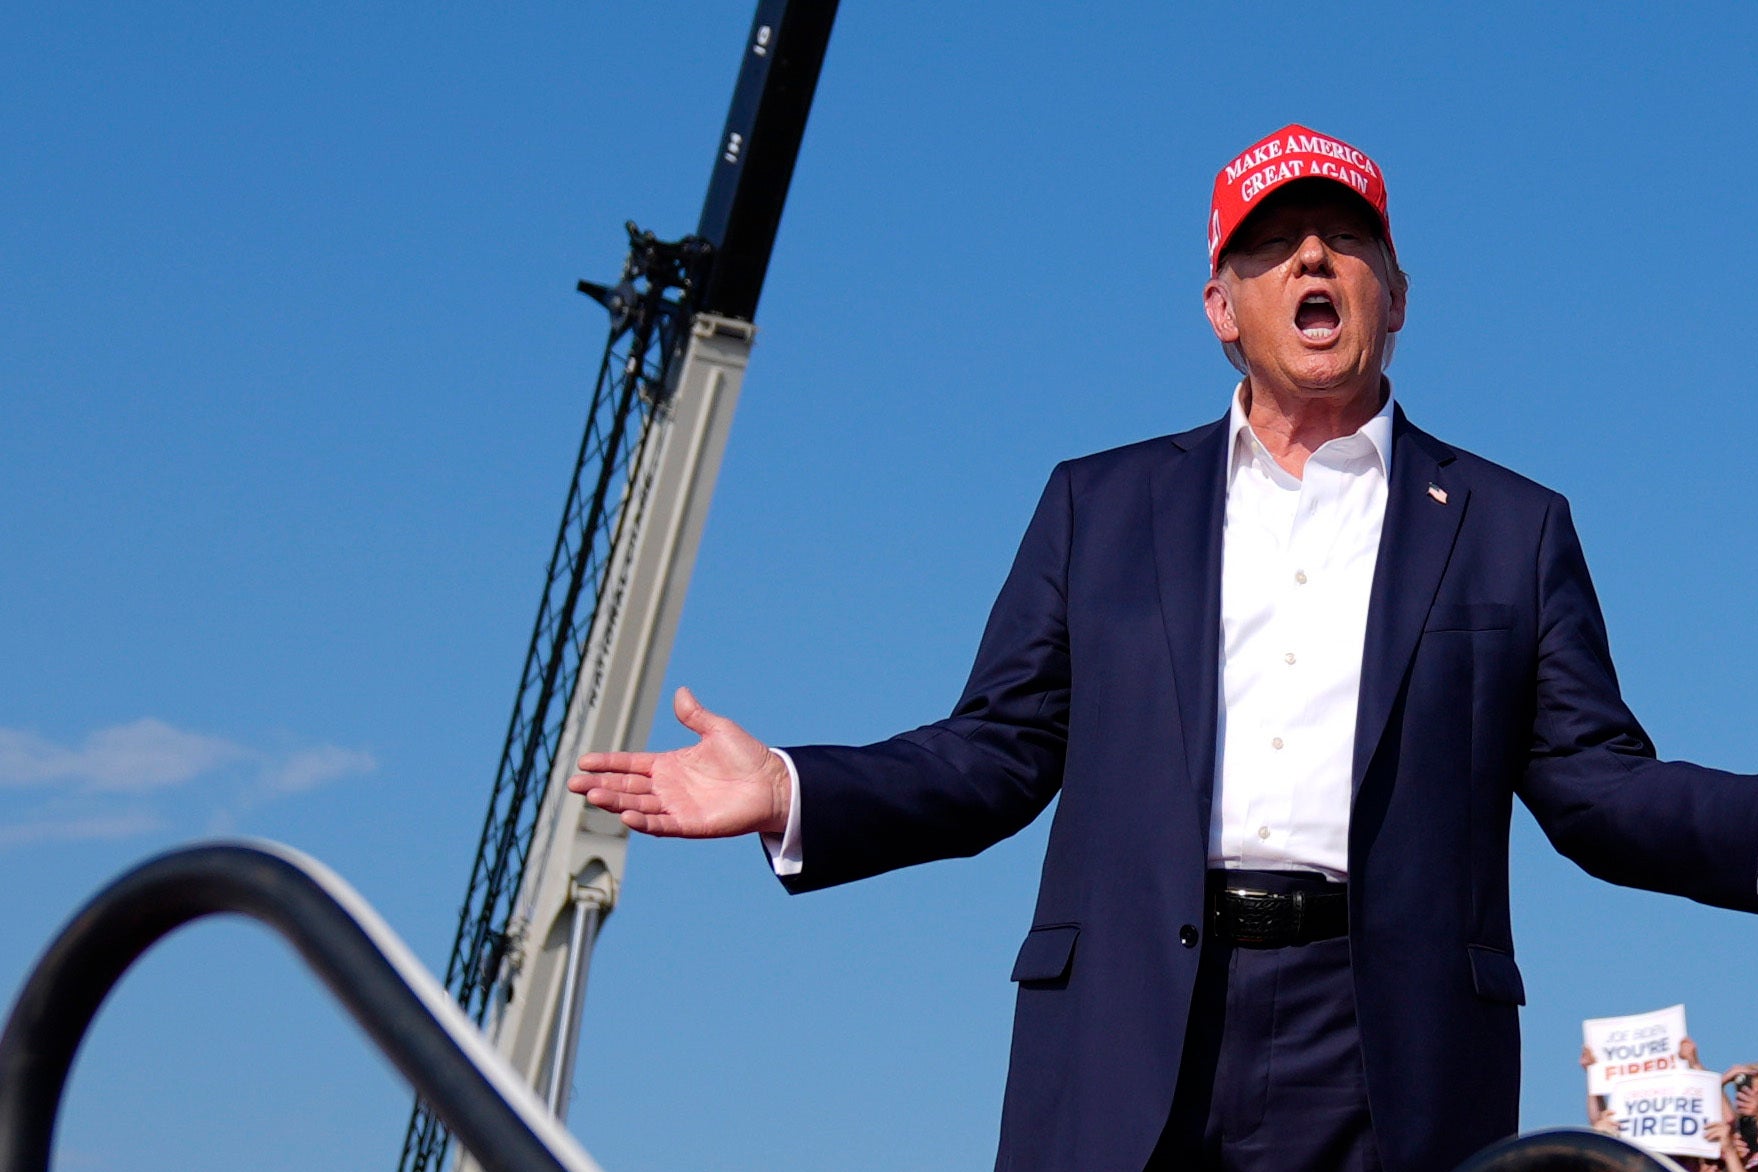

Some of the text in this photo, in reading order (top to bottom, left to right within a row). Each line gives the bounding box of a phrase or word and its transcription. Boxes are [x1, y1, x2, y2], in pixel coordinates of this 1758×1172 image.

[1225, 134, 1378, 185] MAKE AMERICA
[1241, 159, 1369, 202] GREAT AGAIN
[1602, 1037, 1671, 1062] YOU'RE
[1604, 1054, 1677, 1083] FIRED!
[1625, 1096, 1704, 1117] YOU'RE
